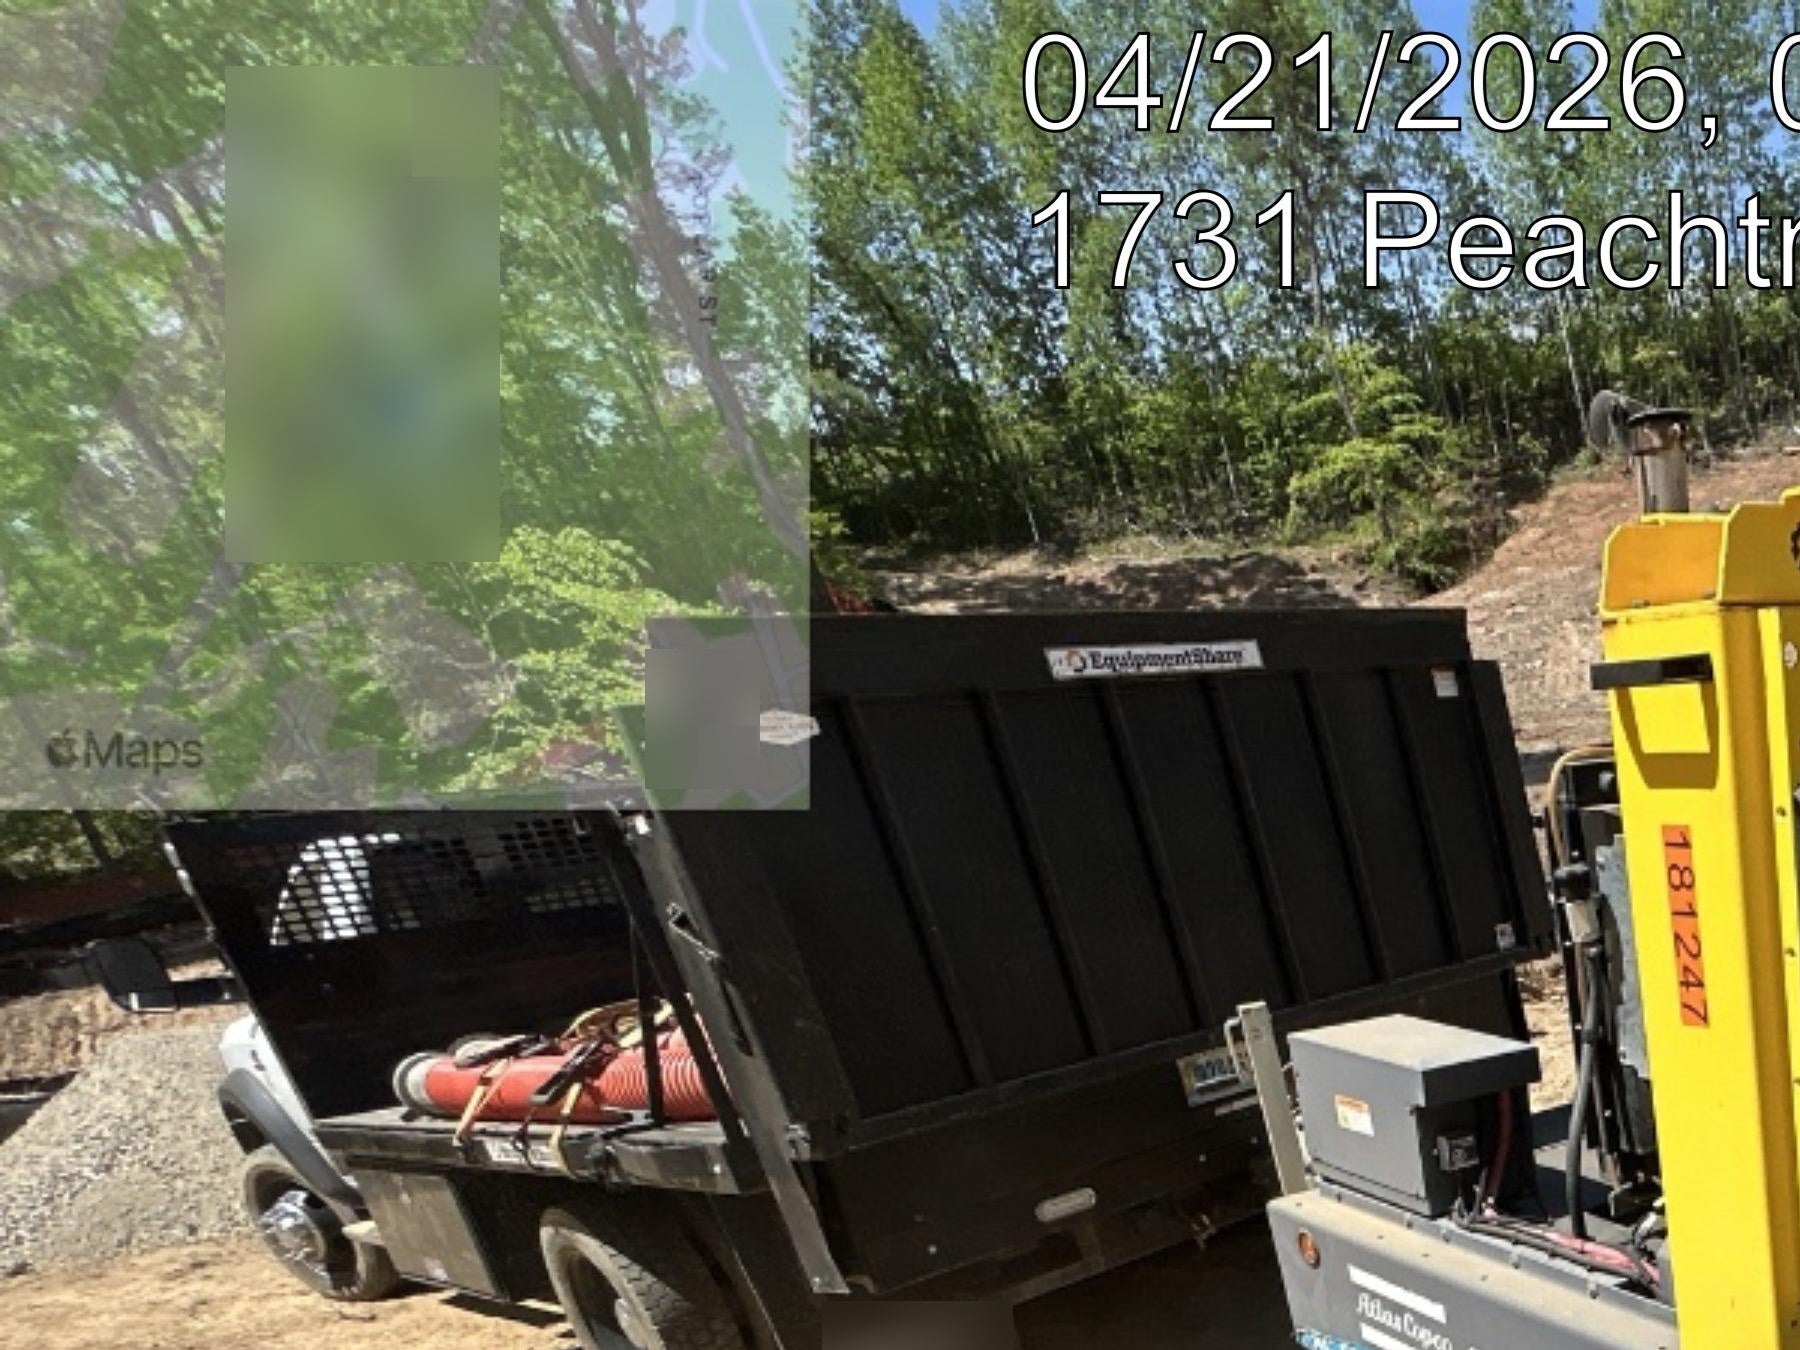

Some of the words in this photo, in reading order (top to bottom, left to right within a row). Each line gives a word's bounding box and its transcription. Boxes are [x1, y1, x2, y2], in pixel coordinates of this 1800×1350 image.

[1087, 646, 1243, 672] EquipmentShare
[1664, 829, 1709, 1024] 181247
[1356, 1292, 1402, 1331] Atlas
